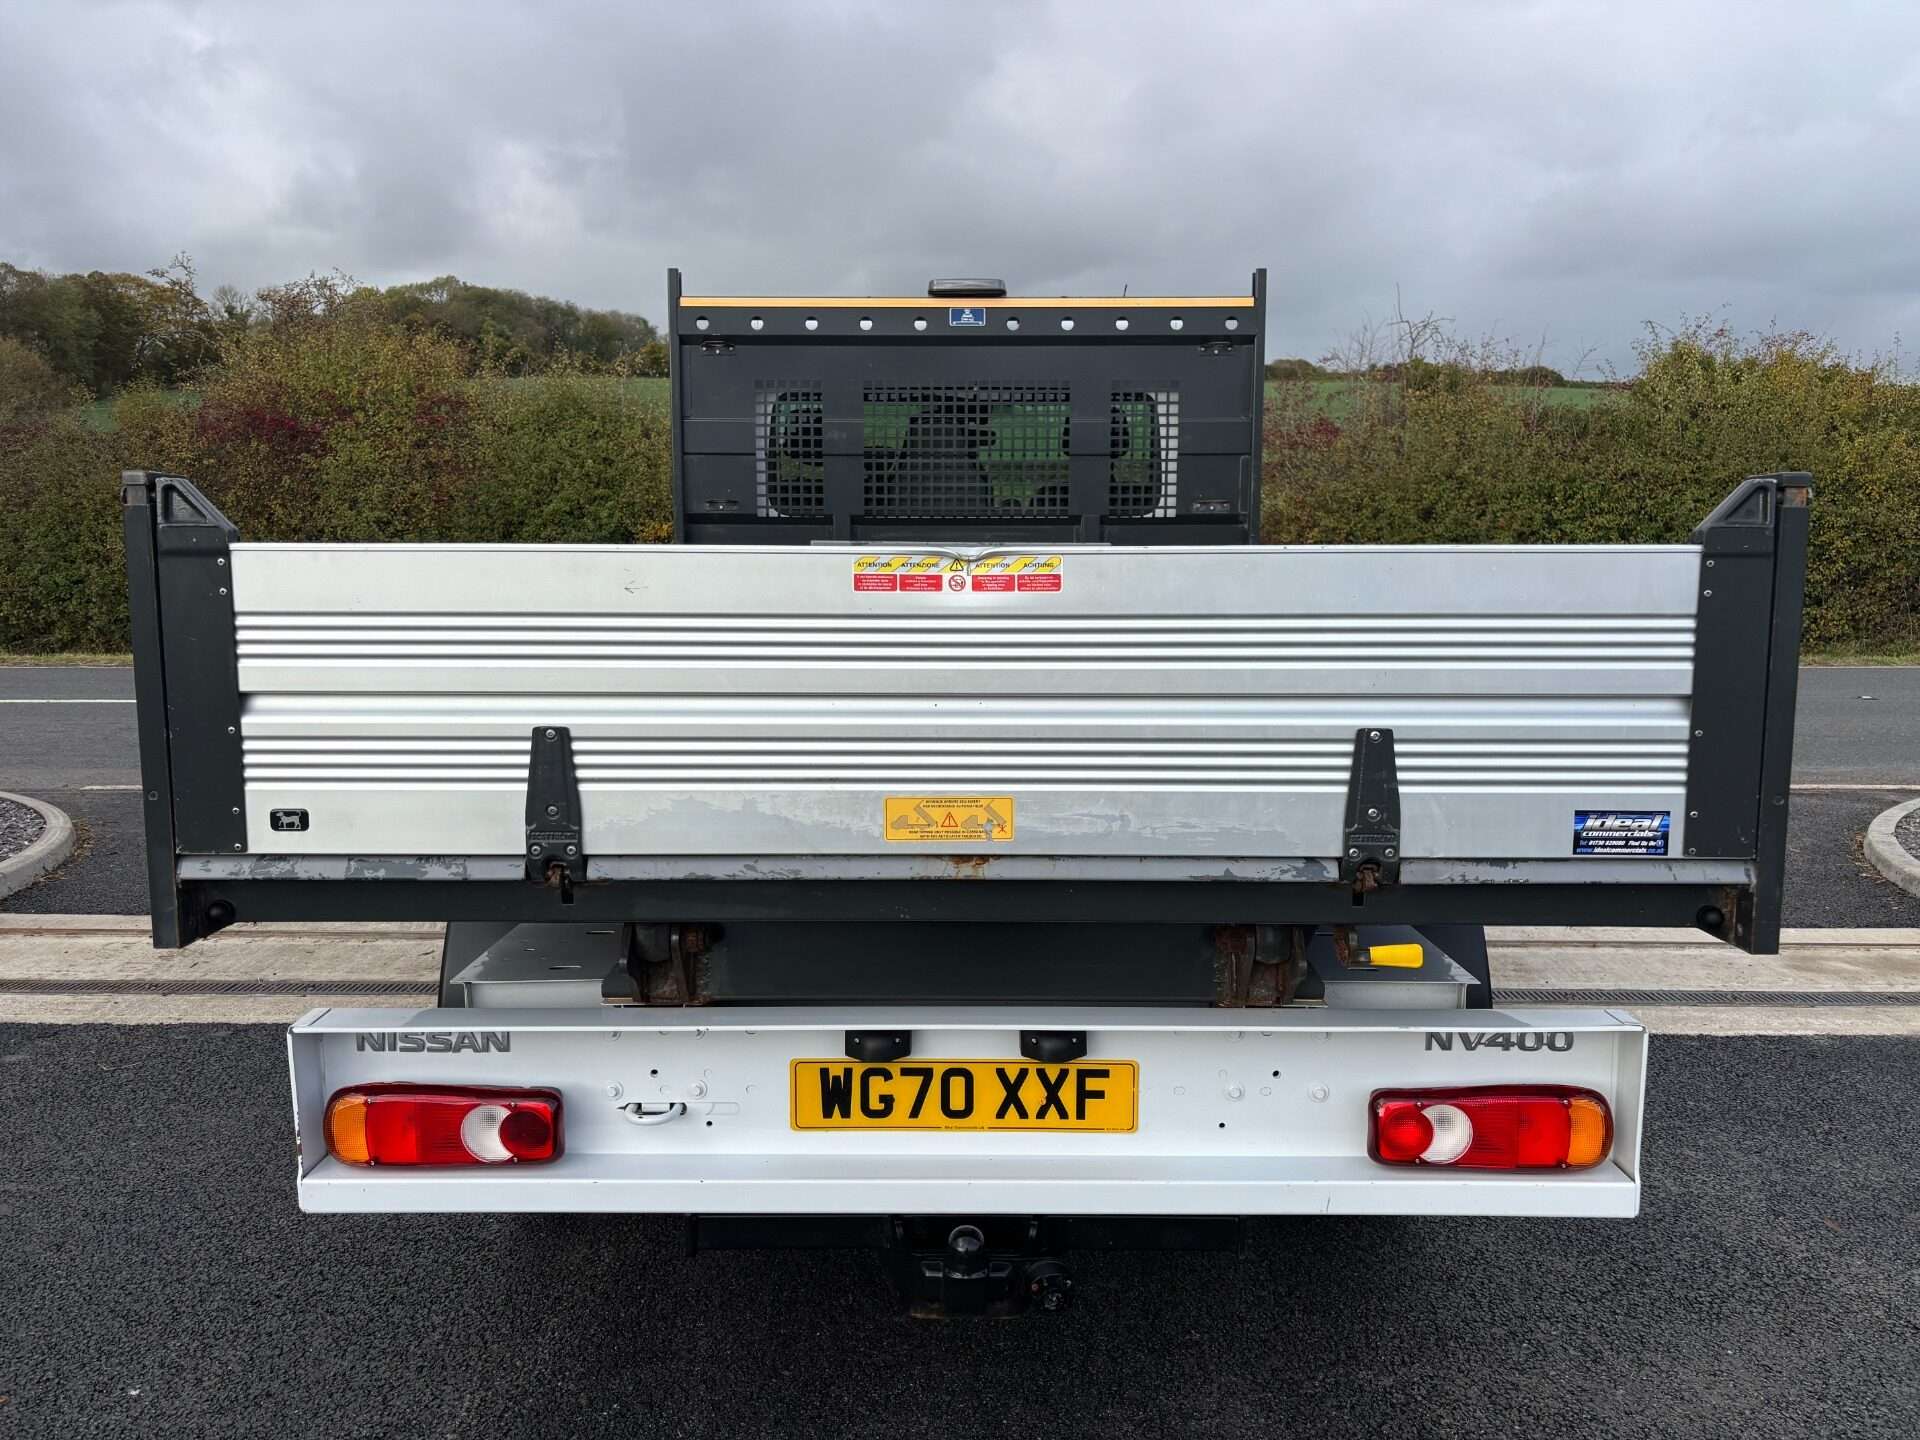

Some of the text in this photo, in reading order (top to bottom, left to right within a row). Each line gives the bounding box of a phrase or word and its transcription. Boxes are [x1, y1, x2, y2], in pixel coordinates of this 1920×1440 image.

[857, 561, 892, 569] ATTENTION
[1582, 814, 1665, 831] ideal
[1582, 830, 1656, 838] commercials
[355, 1031, 511, 1053] NISSAN
[1424, 1031, 1575, 1052] NV400
[819, 1067, 1111, 1121] WG70 XXF
